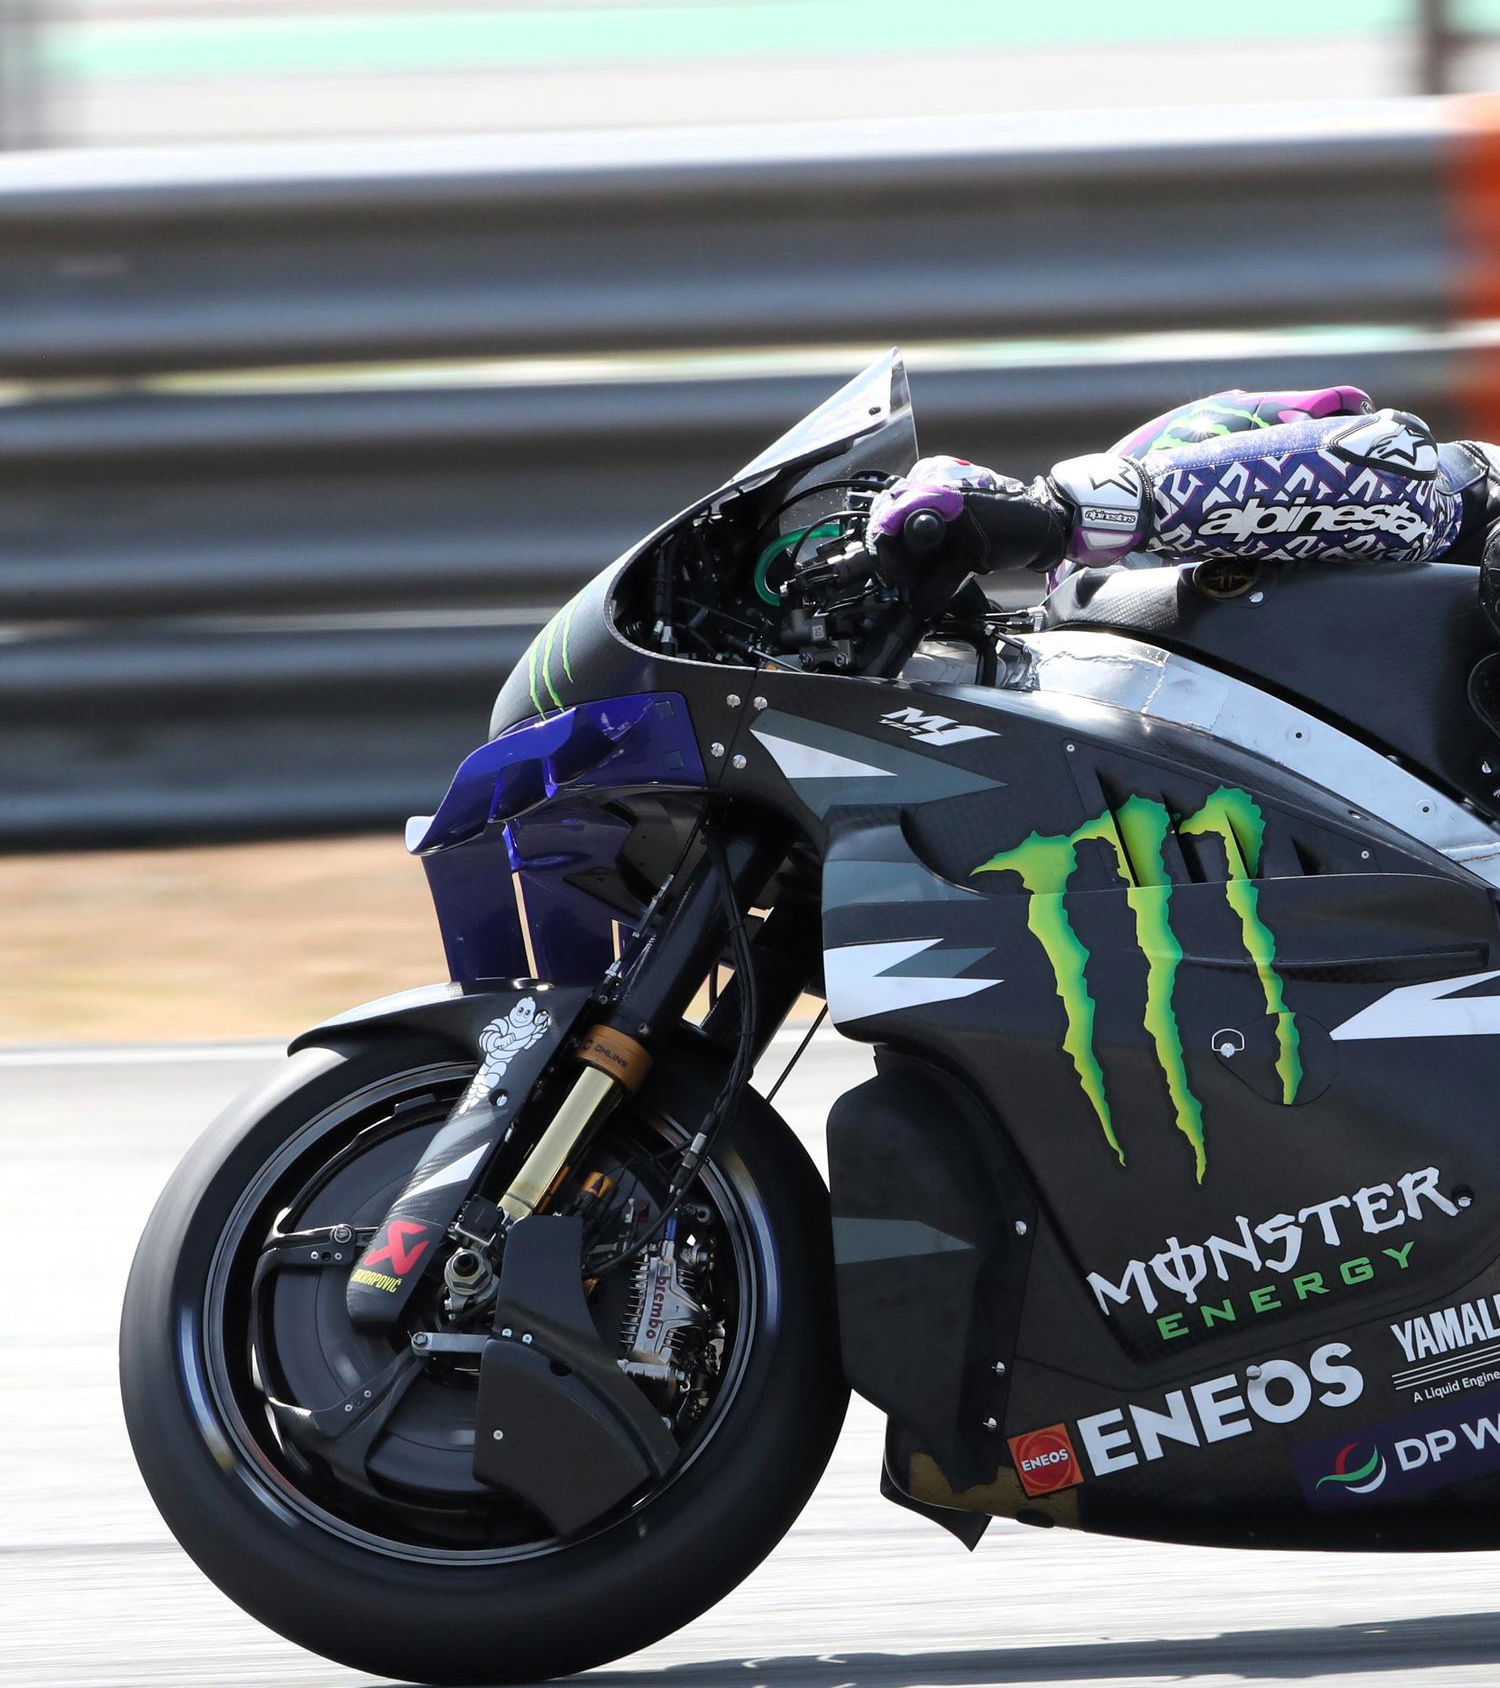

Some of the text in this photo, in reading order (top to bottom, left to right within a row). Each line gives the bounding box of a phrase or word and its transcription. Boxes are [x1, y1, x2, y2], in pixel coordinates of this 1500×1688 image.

[1085, 510, 1136, 523] alpinestars
[1198, 497, 1432, 543] alpinestar
[880, 706, 1002, 746] M1
[1086, 1166, 1460, 1316] MONSTER
[646, 1276, 671, 1340] brembo
[1157, 1241, 1417, 1340] ENERGY
[1076, 1342, 1365, 1477] ENEOS
[1413, 1391, 1423, 1404] A
[1424, 1380, 1461, 1403] Liquid
[1461, 1370, 1500, 1389] Engine
[1021, 1448, 1069, 1471] ENEOS
[1395, 1428, 1458, 1472] DP
